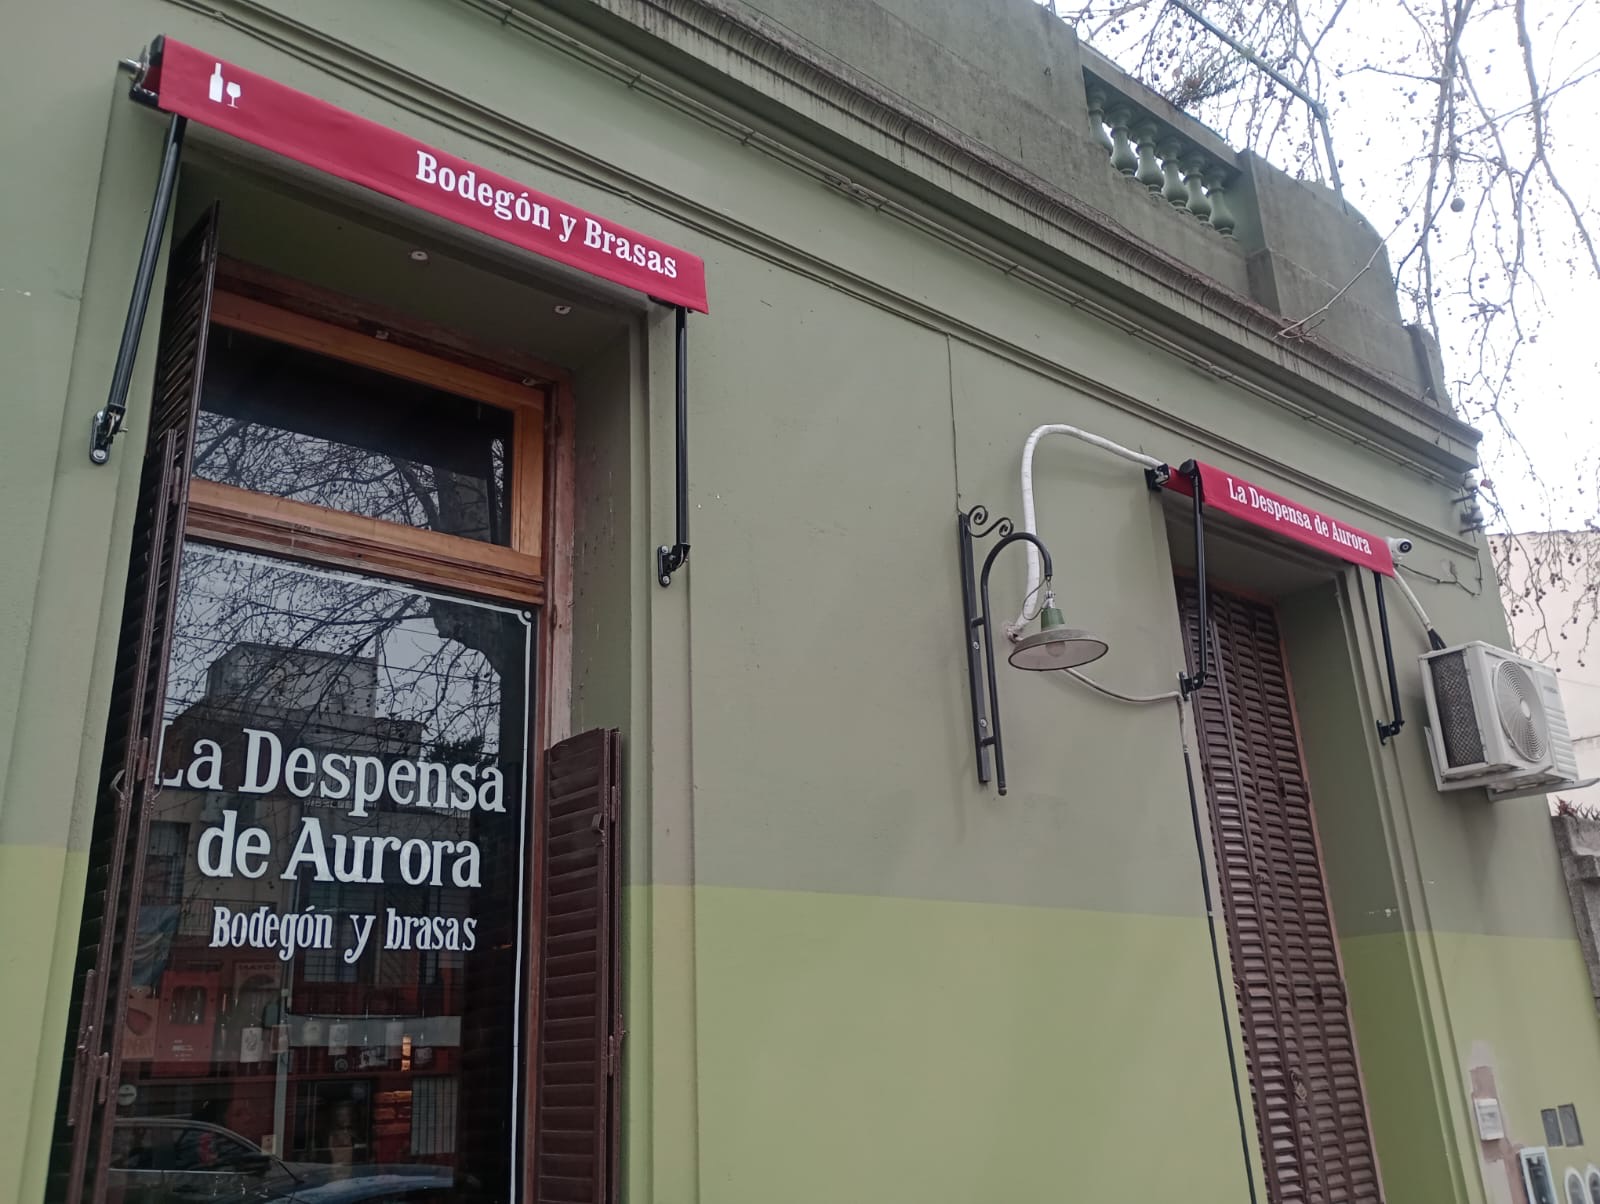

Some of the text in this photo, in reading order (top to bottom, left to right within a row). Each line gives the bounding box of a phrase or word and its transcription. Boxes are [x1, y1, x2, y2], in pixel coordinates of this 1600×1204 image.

[416, 150, 677, 278] Bodegón y Brasas
[1227, 477, 1372, 555] La Despensa de Aurora
[154, 719, 506, 817] La Despensa
[197, 810, 481, 888] de Aurora
[209, 905, 476, 964] Bodegón y brasas
